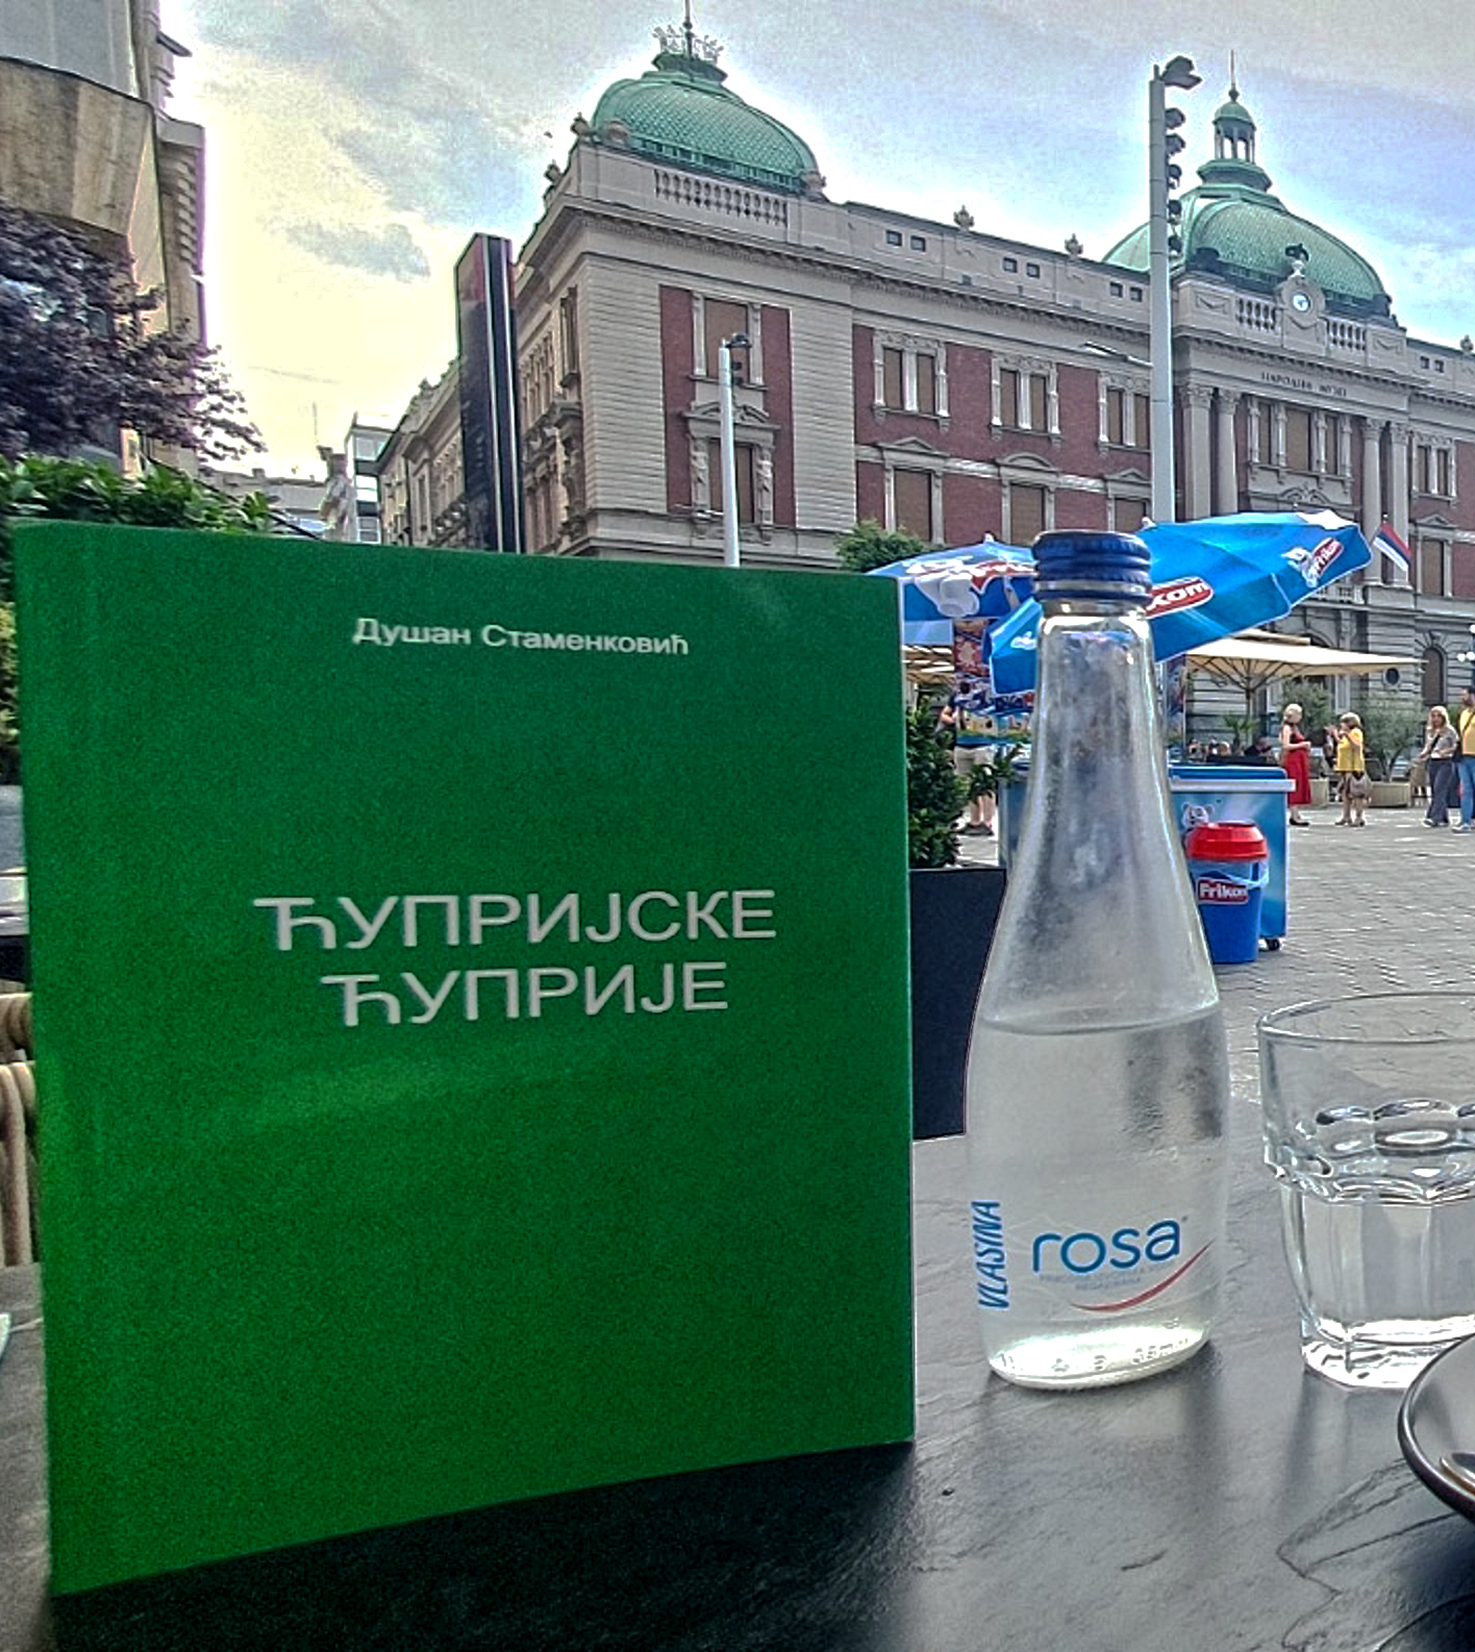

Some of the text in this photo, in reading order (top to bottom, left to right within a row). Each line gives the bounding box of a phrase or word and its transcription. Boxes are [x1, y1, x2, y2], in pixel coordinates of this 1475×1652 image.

[353, 617, 690, 655] Душан Стаменковић
[252, 889, 777, 952] ЋУПРИЈСКЕ
[320, 960, 729, 1027] ЋУПРИЈЕ
[969, 1200, 1009, 1309] VLASINA
[1031, 1218, 1181, 1274] rosa
